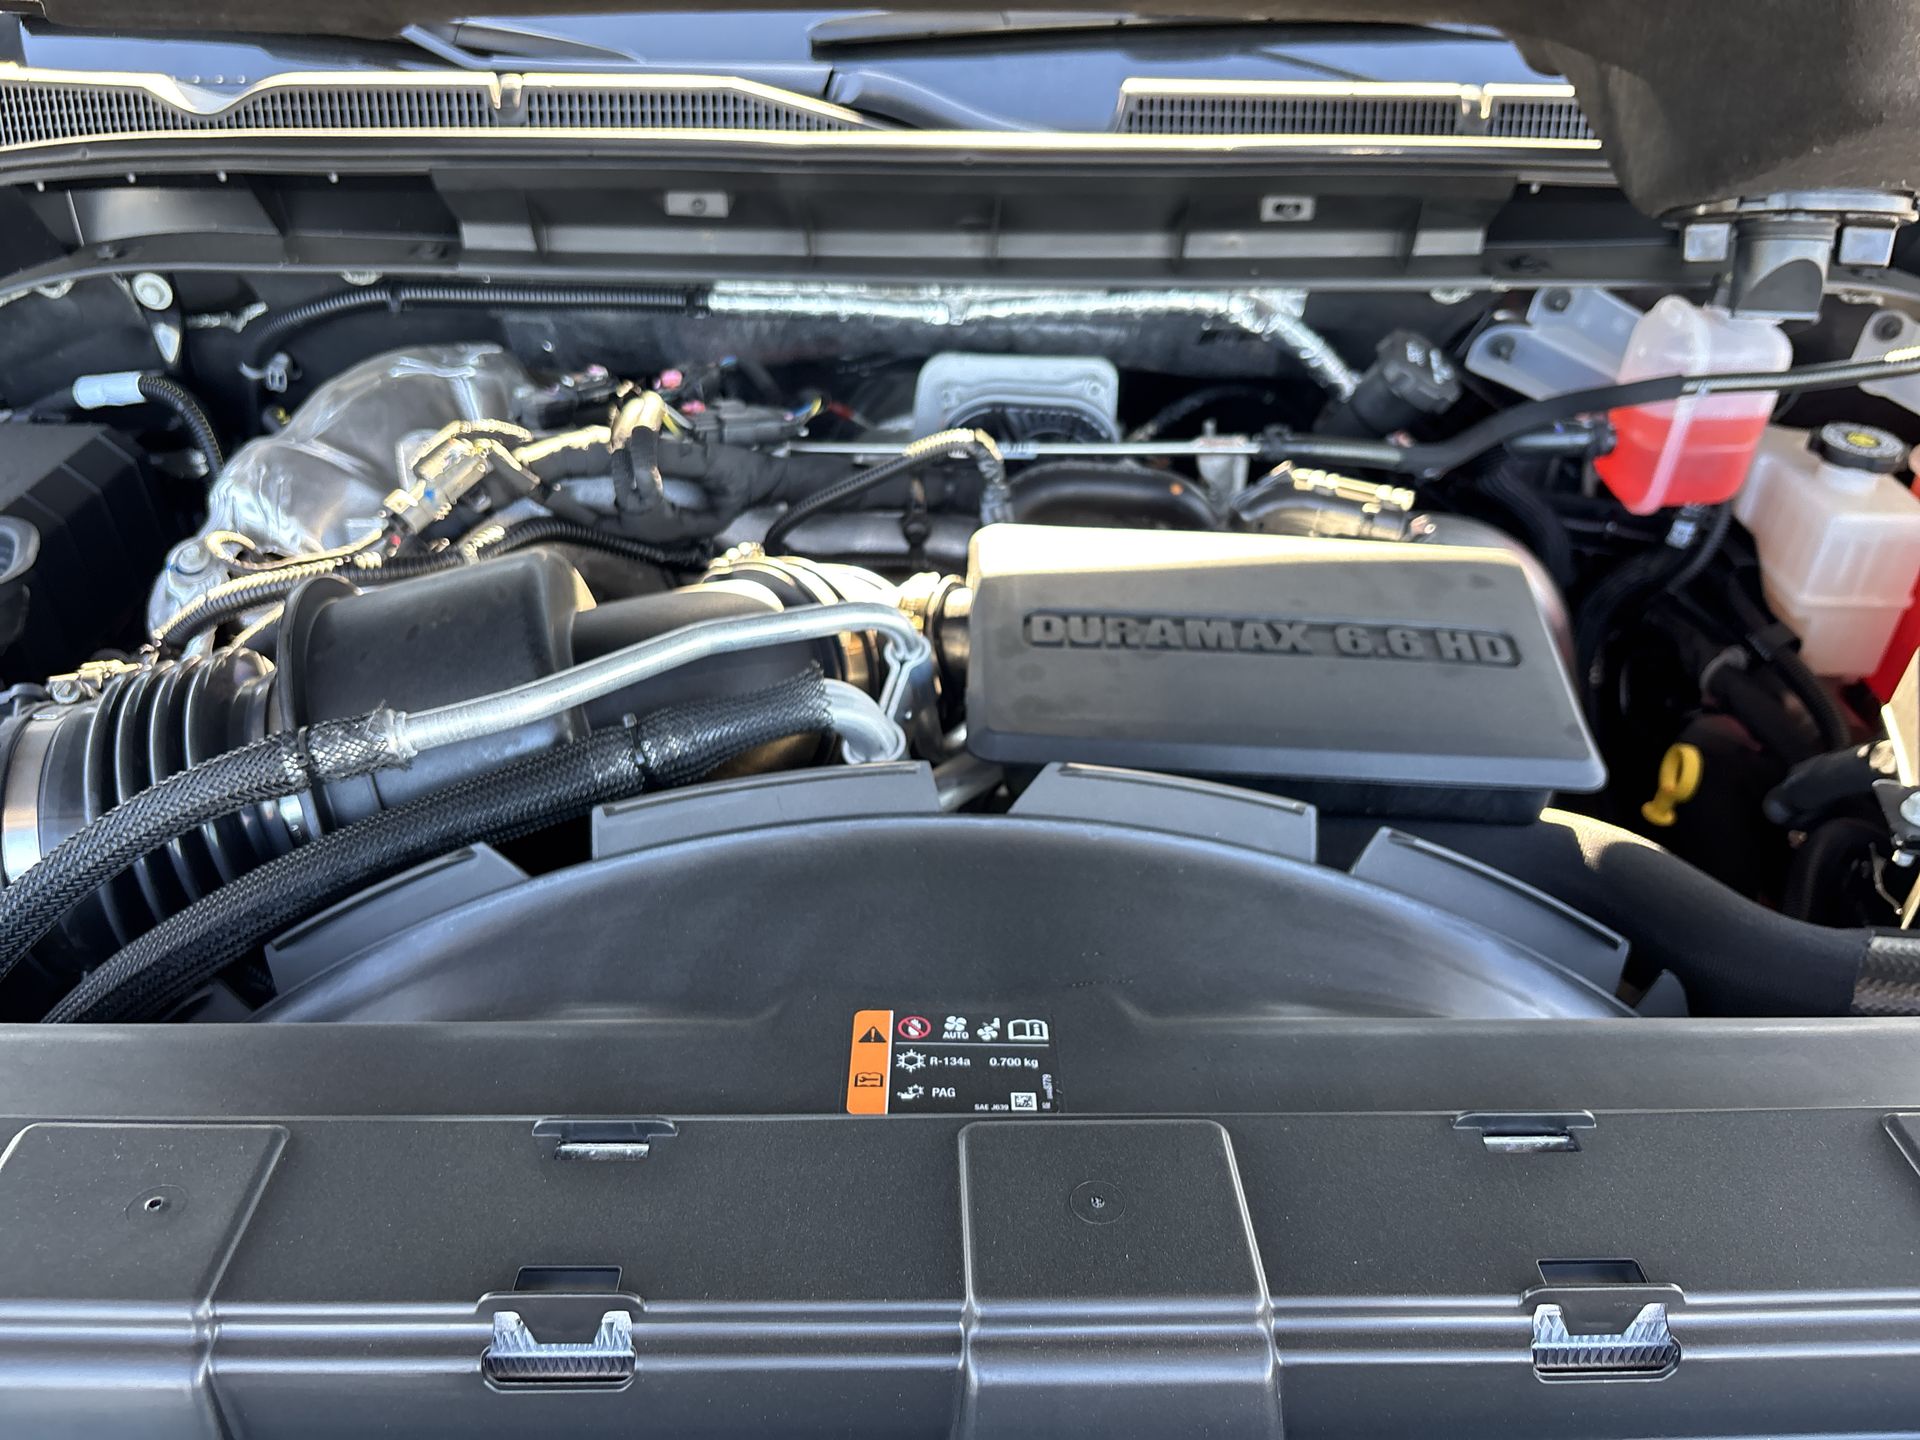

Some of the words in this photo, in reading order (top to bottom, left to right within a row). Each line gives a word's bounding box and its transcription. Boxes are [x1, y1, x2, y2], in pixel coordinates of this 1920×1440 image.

[1030, 614, 1312, 653] DURAMAX
[1335, 626, 1424, 658] 6.6
[1434, 631, 1514, 664] HD
[942, 1031, 969, 1040] AUTO
[930, 1056, 971, 1066] R-134a
[989, 1057, 1021, 1067] 0.700
[1023, 1057, 1039, 1069] kg
[931, 1087, 956, 1098] PAG
[974, 1103, 989, 1111] SAE
